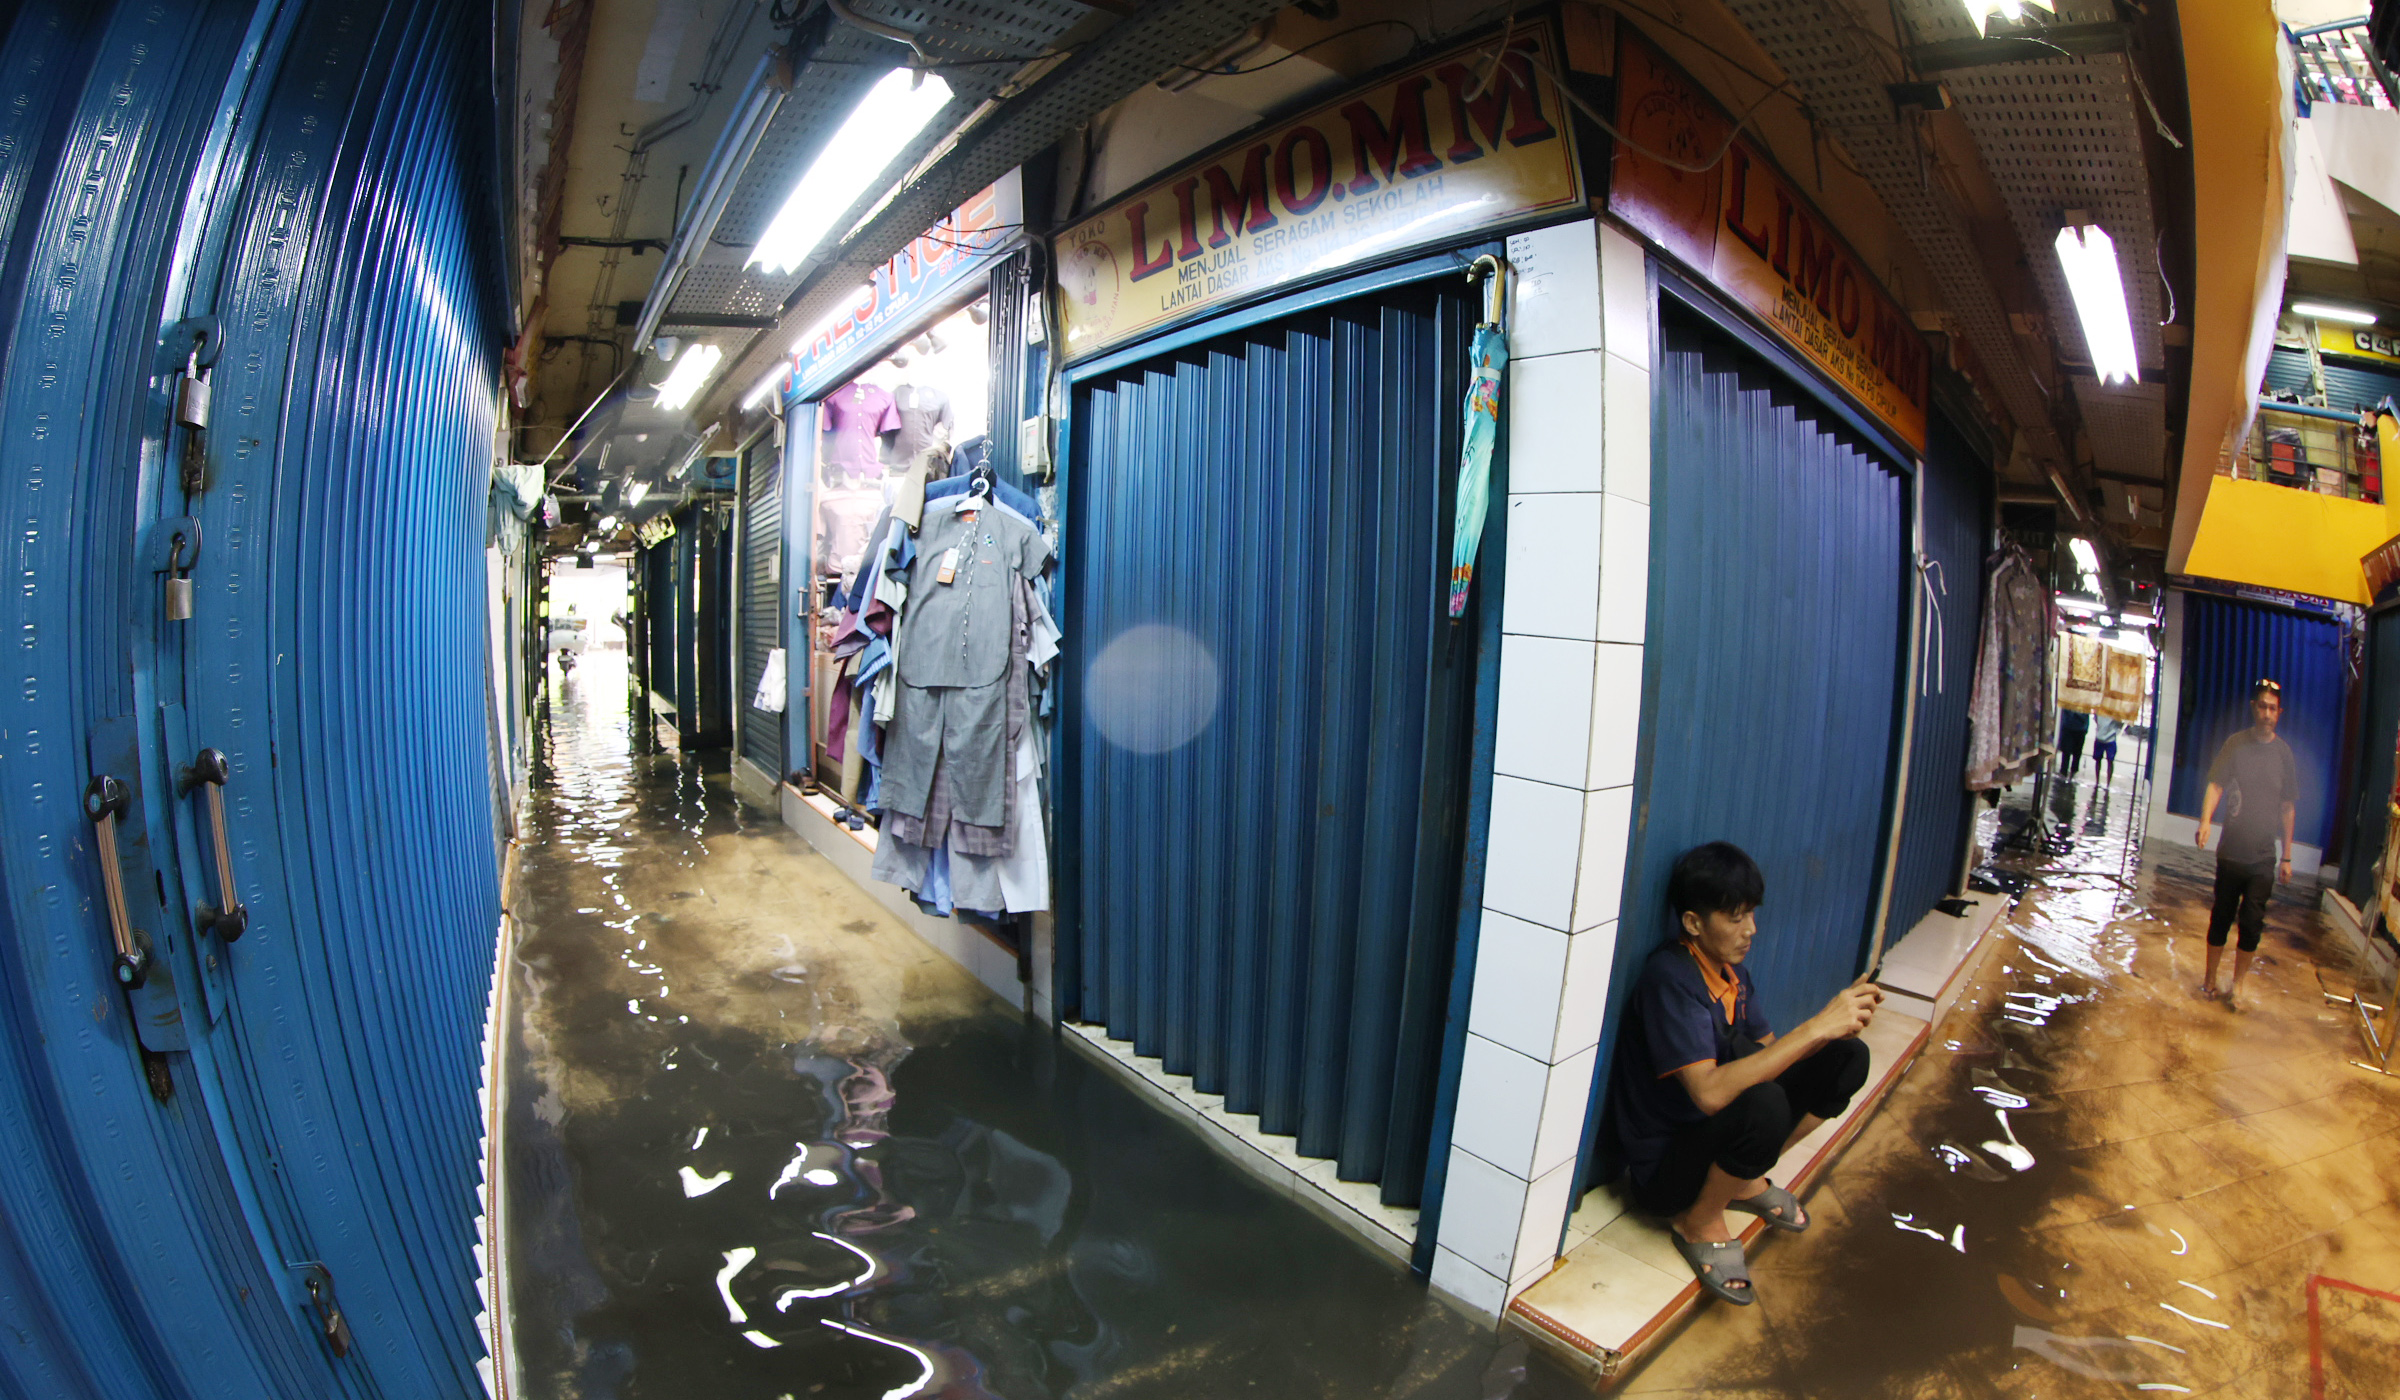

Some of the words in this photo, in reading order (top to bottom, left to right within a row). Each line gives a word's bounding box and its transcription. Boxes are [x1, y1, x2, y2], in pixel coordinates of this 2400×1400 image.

[1125, 37, 1557, 282] LIMO.MM
[1069, 220, 1105, 248] TOKO
[1178, 246, 1247, 286] MENJUAL
[1252, 211, 1335, 257] SERAGAM
[1343, 175, 1444, 224] SEKOLAH
[1161, 277, 1203, 312] LANTAI
[1208, 263, 1250, 296] DASAR
[1256, 252, 1285, 279] AKS
[1782, 285, 1819, 331] MENJUAL
[1773, 298, 1802, 338] LANTAI
[1804, 327, 1829, 360] DASAR
[1830, 351, 1845, 374] AKS
